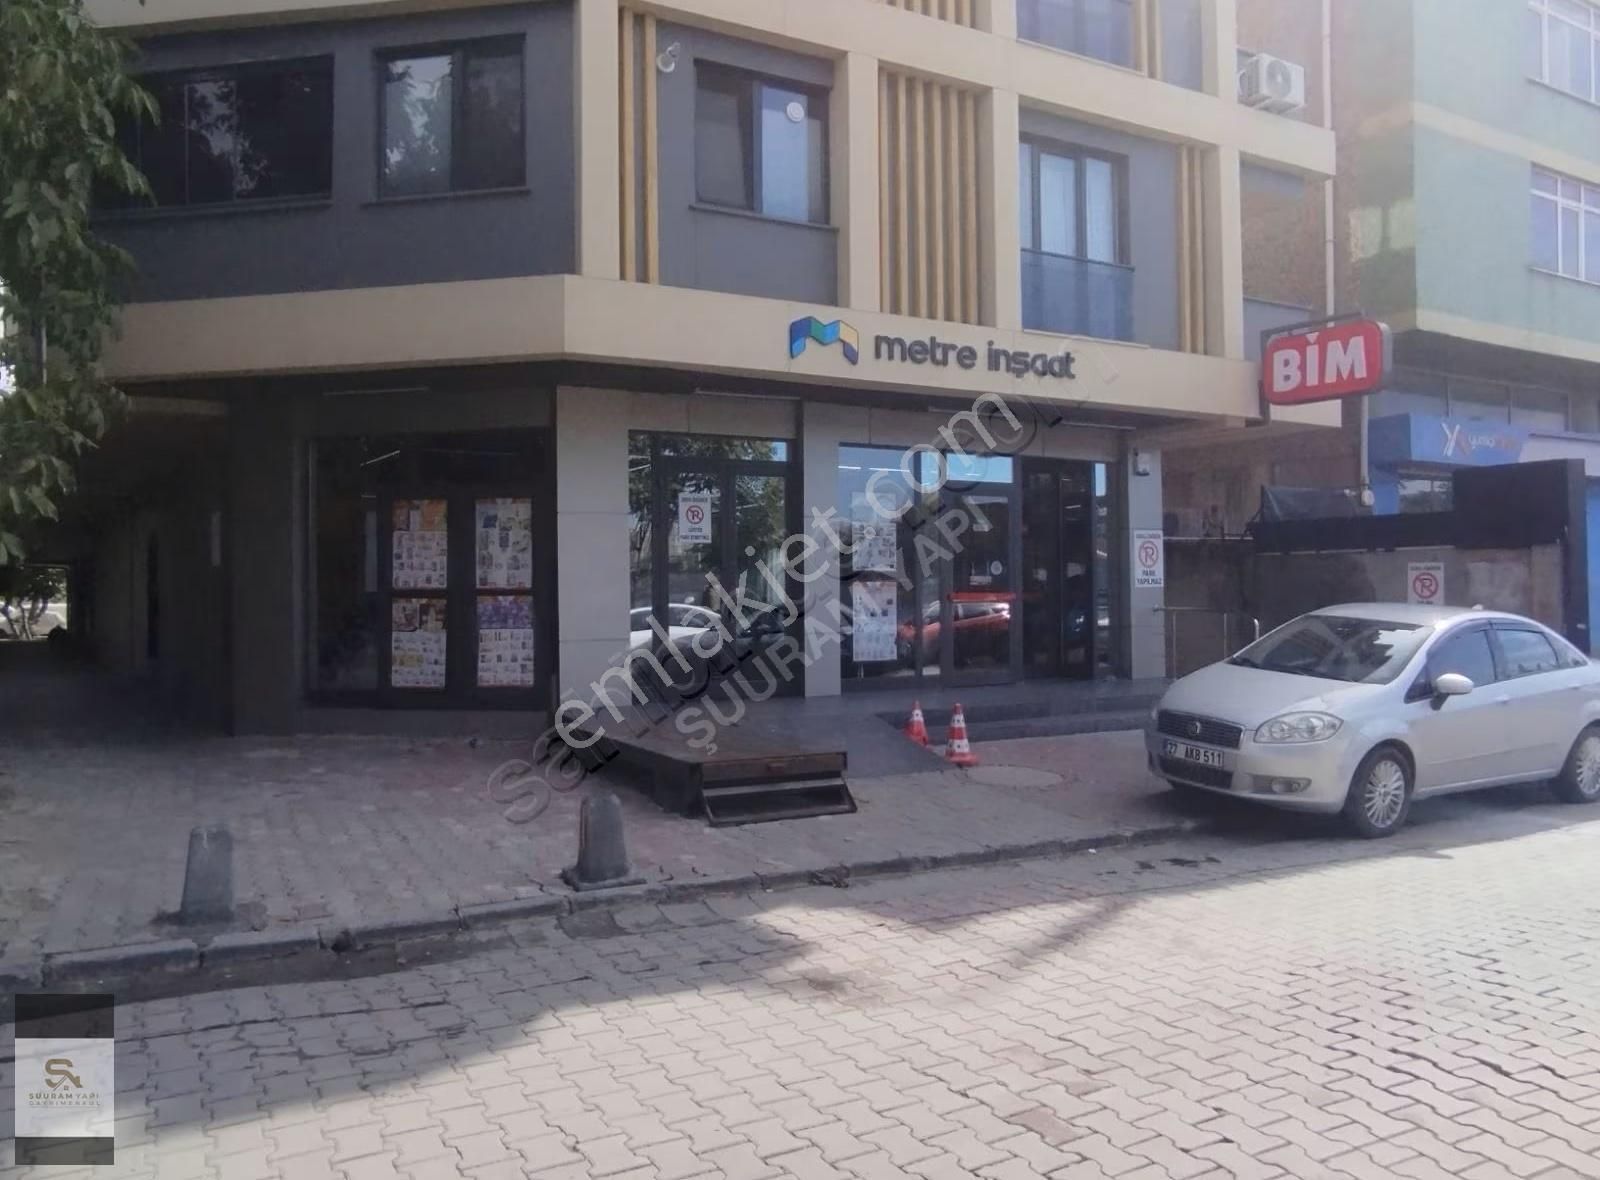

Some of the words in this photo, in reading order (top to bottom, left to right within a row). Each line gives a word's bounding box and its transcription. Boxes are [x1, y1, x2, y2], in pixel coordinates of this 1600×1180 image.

[874, 334, 978, 369] metre
[987, 340, 1076, 379] inşaat
[1272, 331, 1368, 393] BİM
[1203, 750, 1221, 766] 511
